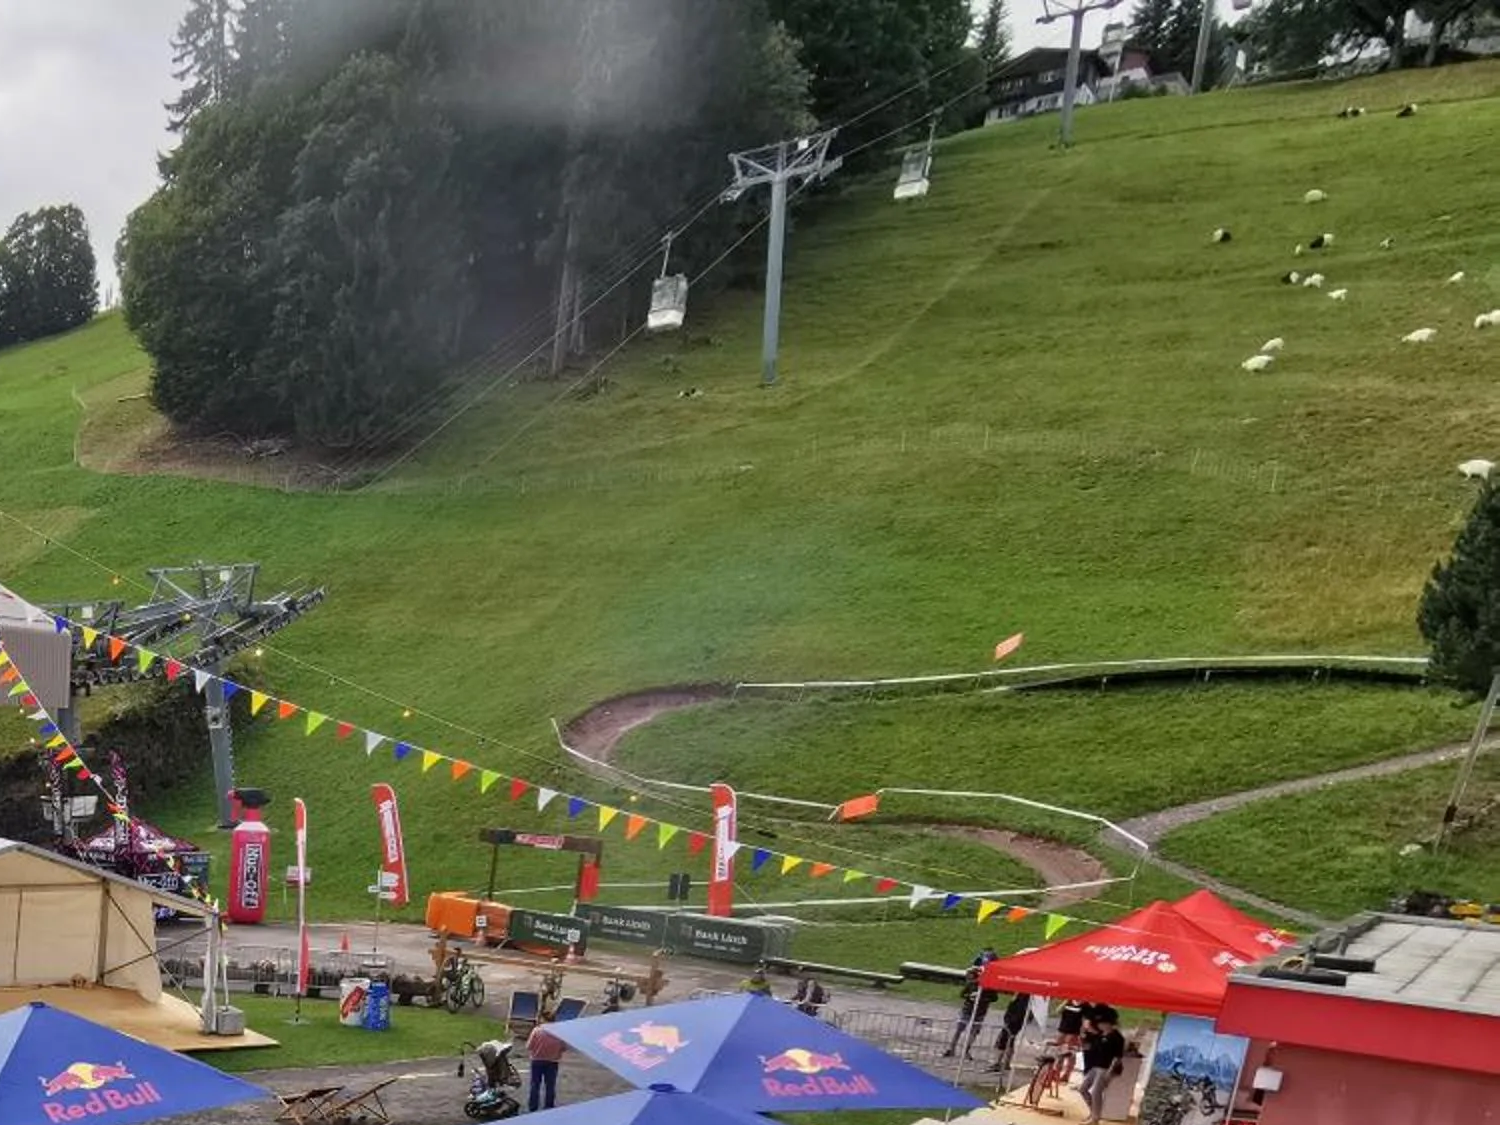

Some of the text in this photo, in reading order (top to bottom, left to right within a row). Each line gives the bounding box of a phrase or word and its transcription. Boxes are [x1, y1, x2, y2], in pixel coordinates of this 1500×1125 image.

[602, 915, 625, 926] Bank
[695, 930, 719, 941] Bank
[762, 1074, 878, 1097] Red Bull
[43, 1081, 162, 1123] Red Bull
